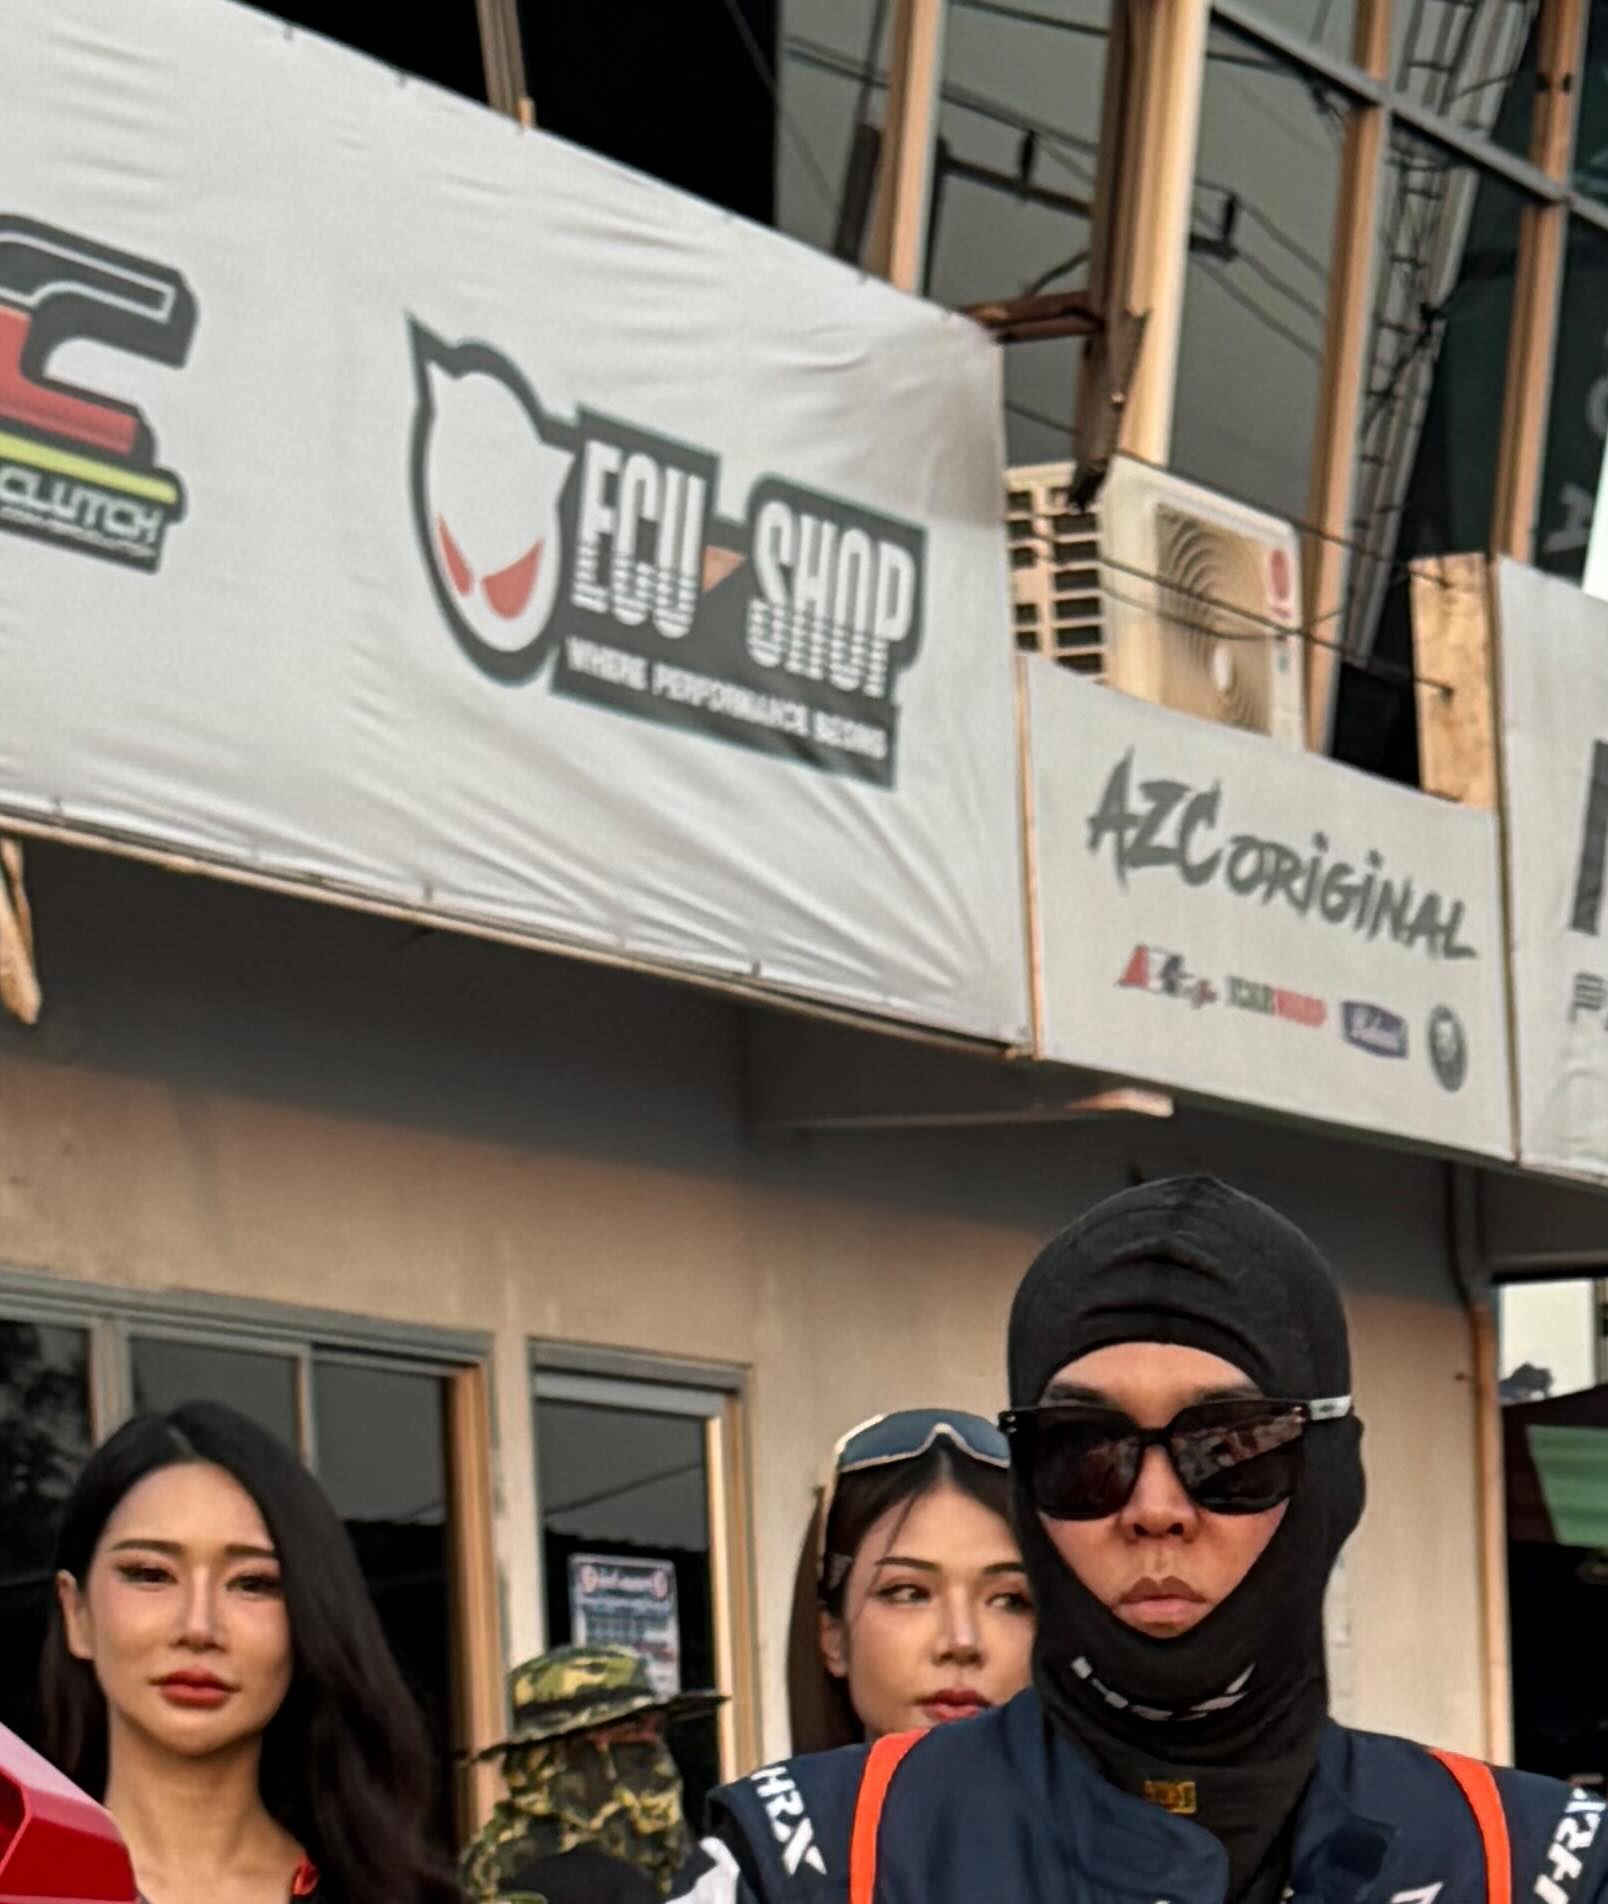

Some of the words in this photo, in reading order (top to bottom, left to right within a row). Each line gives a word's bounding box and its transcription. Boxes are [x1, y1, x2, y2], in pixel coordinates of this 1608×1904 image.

[566, 636, 647, 691] WHERE
[652, 663, 808, 738] PERFORMANCE
[1088, 743, 1222, 892] AZC
[753, 1766, 828, 1877] HRX
